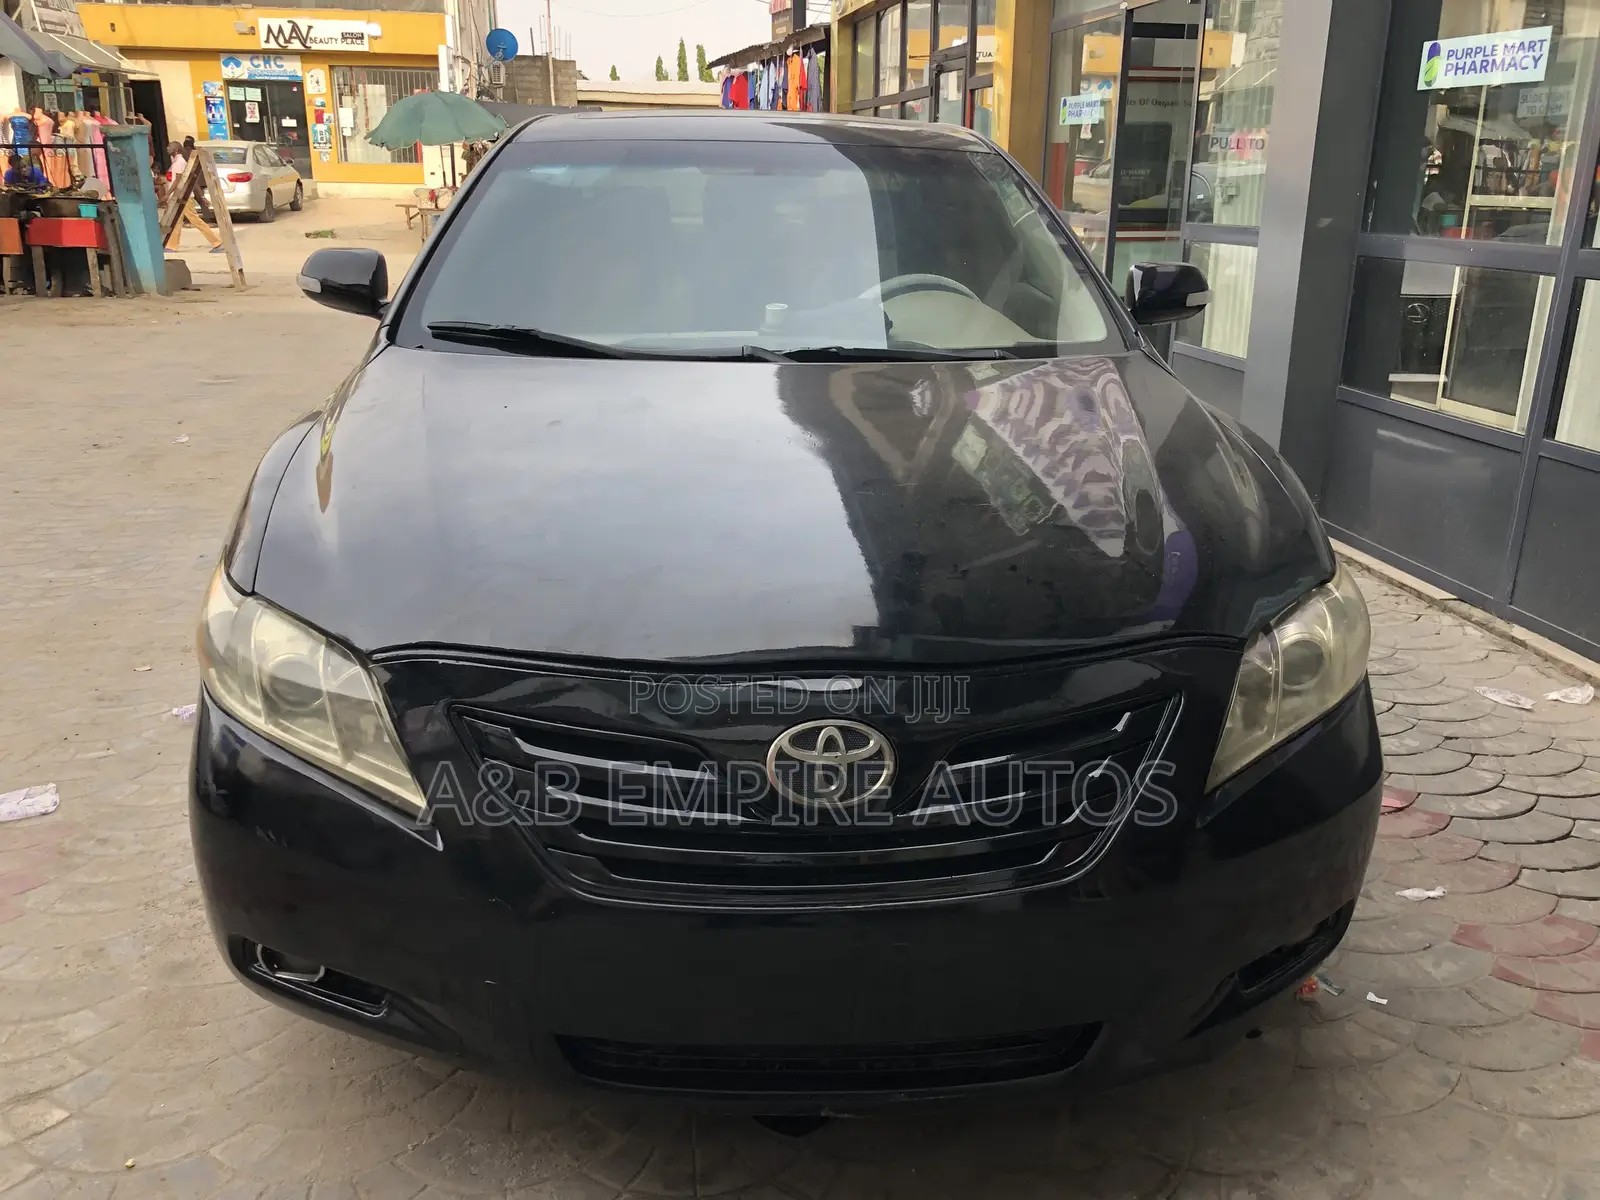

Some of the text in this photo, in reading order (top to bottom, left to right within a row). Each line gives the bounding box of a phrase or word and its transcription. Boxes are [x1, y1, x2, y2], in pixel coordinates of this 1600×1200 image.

[309, 37, 338, 45] BEAUTY
[341, 37, 365, 45] PLACE
[1447, 39, 1547, 61] PURPLE MART
[249, 55, 285, 69] CHC
[1444, 54, 1543, 76] PHARMACY
[1086, 100, 1100, 108] MART
[1210, 137, 1265, 150] PULL TO
